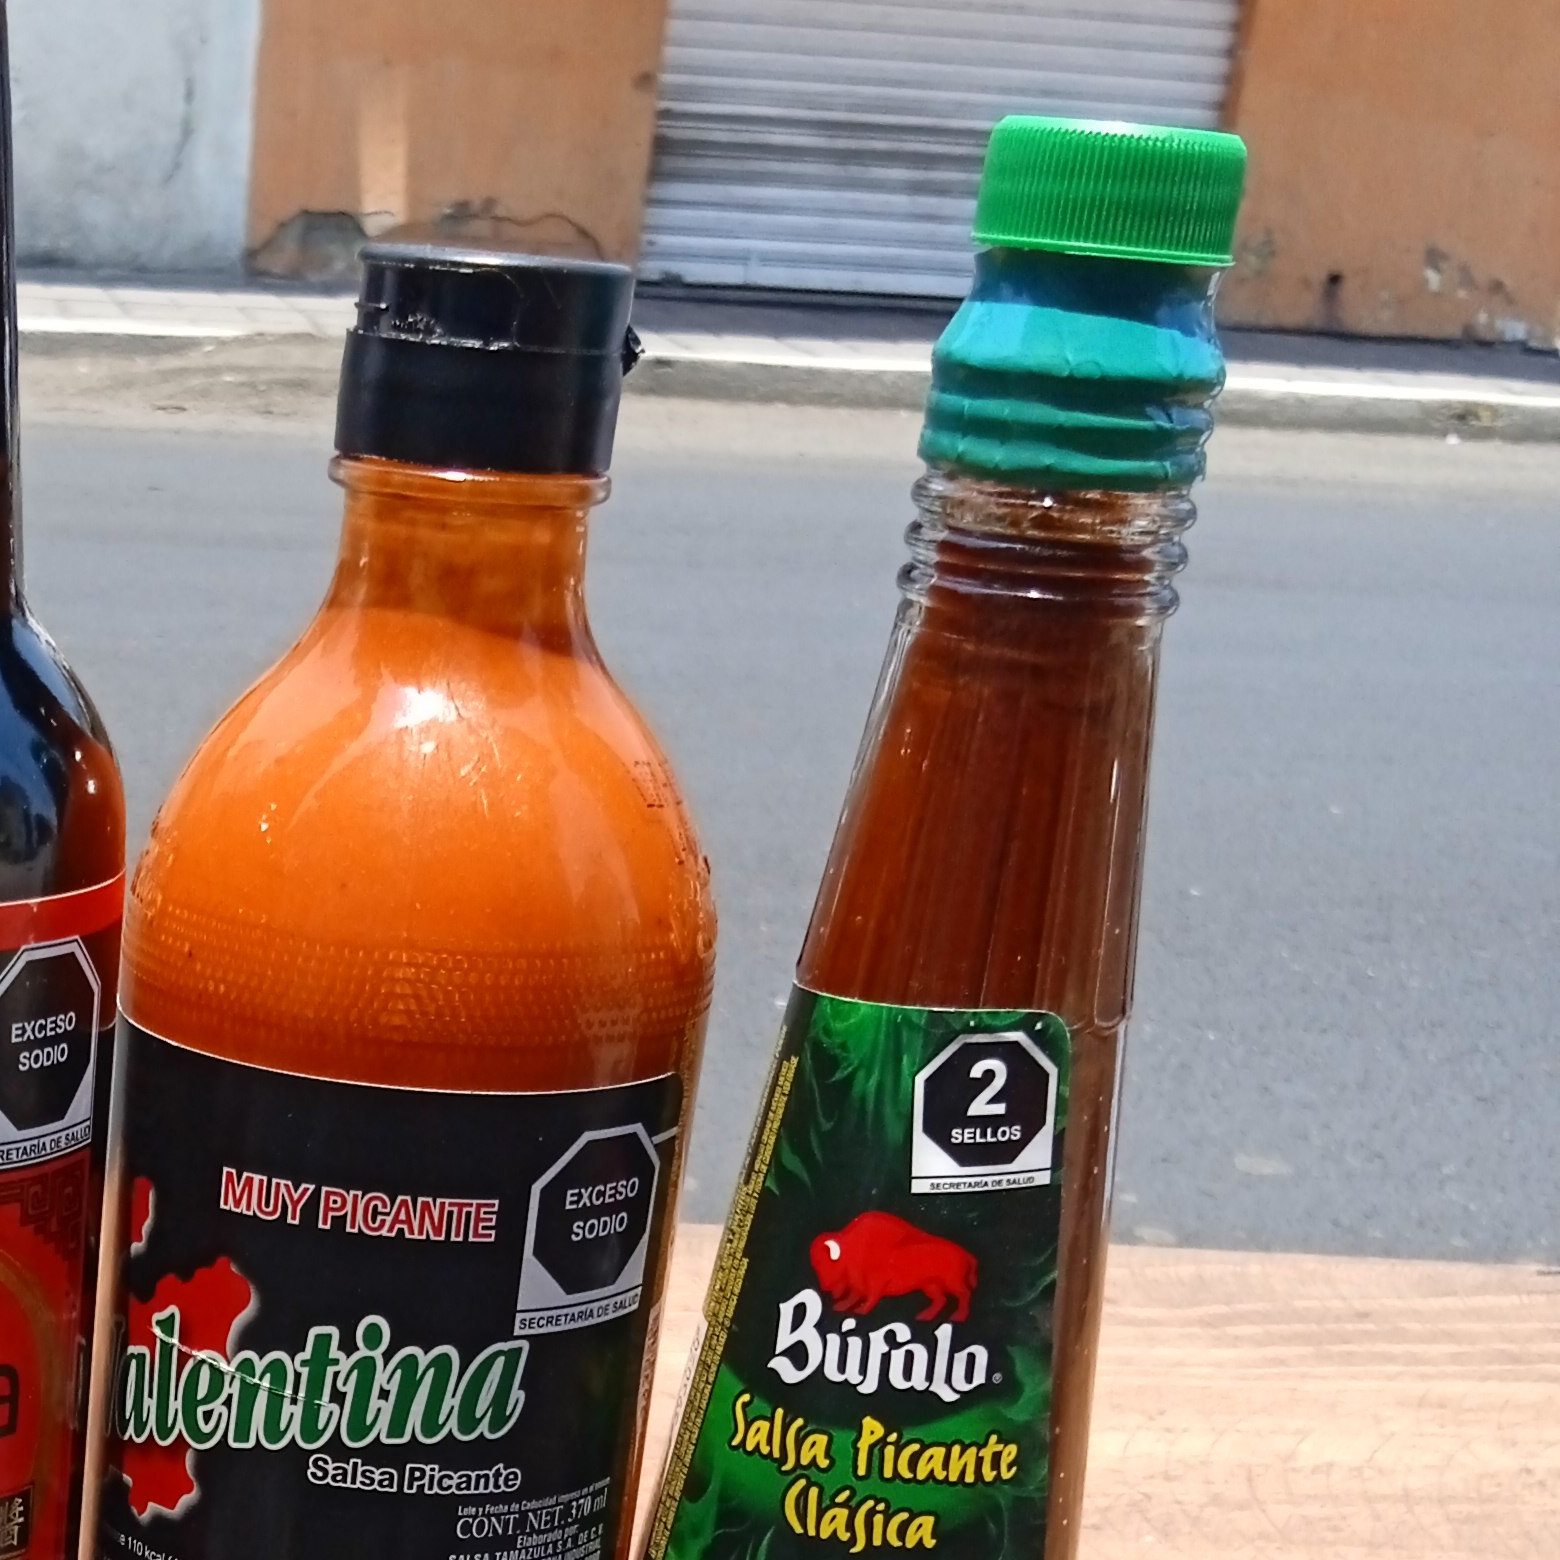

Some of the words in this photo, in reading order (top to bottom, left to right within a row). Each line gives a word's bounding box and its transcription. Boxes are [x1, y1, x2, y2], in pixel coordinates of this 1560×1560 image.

[11, 1011, 76, 1043] EXCESO
[18, 1043, 68, 1071] SODIO
[966, 1059, 1008, 1116] 2
[50, 1136, 62, 1149] DE
[64, 1125, 90, 1146] SALUD
[951, 1125, 1021, 1144] SELLOS
[565, 1177, 639, 1210] EXCESO
[930, 1179, 989, 1191] SECRETARÍA
[992, 1178, 1003, 1187] DE
[1006, 1176, 1035, 1186] SALUD
[220, 1166, 315, 1225] MUY
[318, 1186, 499, 1242] PICANTE
[571, 1212, 627, 1241] SODIO
[519, 1307, 594, 1330] SECRETARÍA
[597, 1304, 609, 1317] DE
[612, 1293, 639, 1313] SALUD
[767, 1288, 989, 1402] Búfalo
[731, 1393, 830, 1471] Salsa
[856, 1416, 1018, 1483] Picante
[307, 1454, 397, 1493] Salsa
[403, 1462, 522, 1494] Picante
[456, 1514, 520, 1539] CONT.
[526, 1505, 565, 1533] NET.
[568, 1496, 591, 1522] 370
[592, 1487, 608, 1512] ml
[784, 1478, 937, 1553] Clásica
[128, 1536, 143, 1556] 110
[517, 1529, 562, 1548] Elaborado
